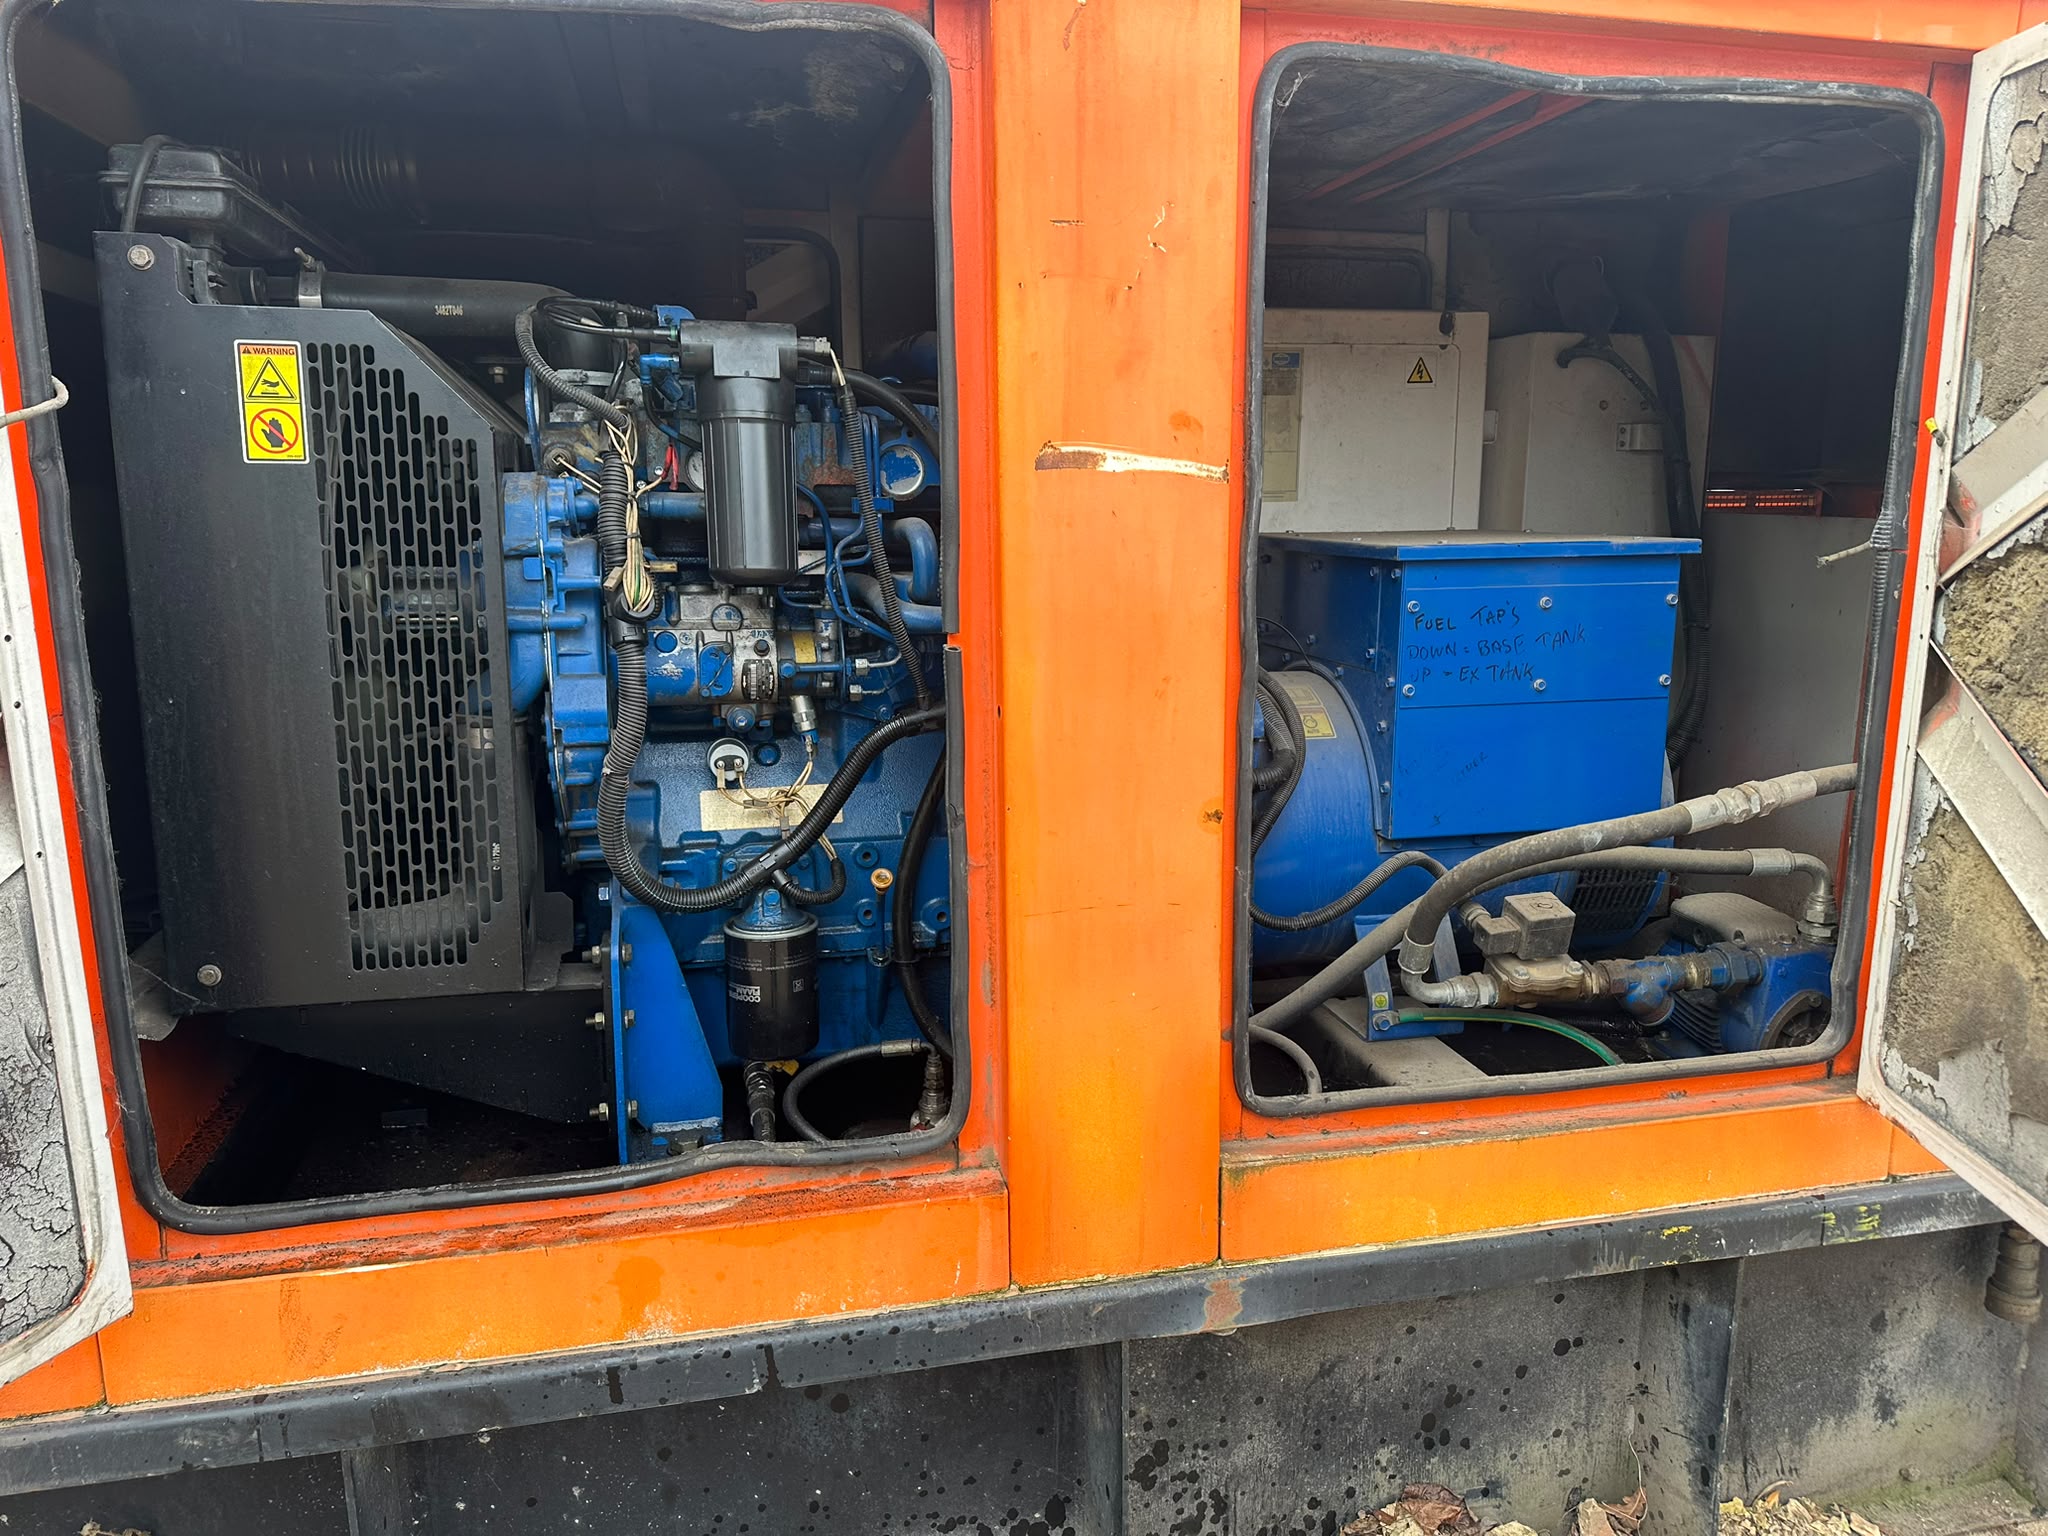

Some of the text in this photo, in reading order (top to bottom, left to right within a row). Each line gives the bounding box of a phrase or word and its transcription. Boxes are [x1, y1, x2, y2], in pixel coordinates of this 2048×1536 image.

[252, 347, 295, 356] WARNING
[1414, 613, 1456, 631] FUEL
[1406, 642, 1456, 660] DOWN
[1535, 624, 1586, 650] TANK
[1459, 665, 1480, 684] EX
[1486, 660, 1535, 682] TANK
